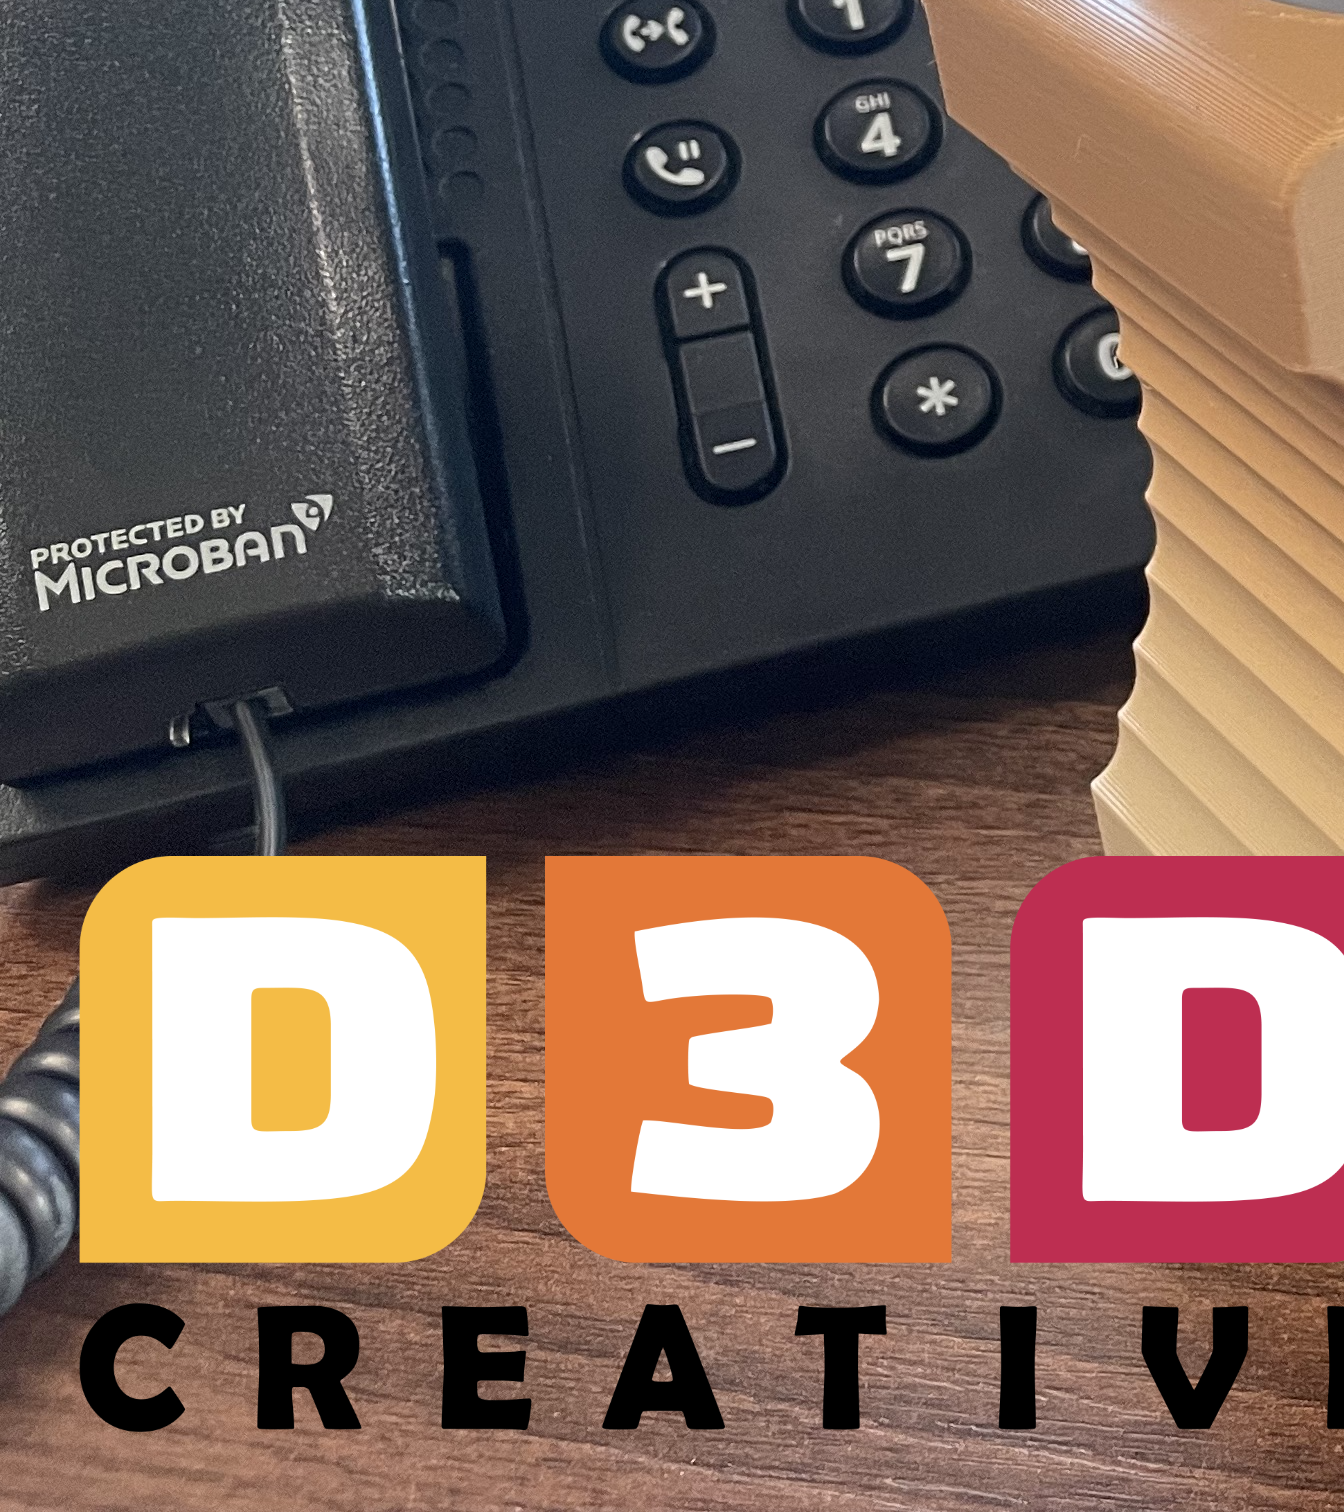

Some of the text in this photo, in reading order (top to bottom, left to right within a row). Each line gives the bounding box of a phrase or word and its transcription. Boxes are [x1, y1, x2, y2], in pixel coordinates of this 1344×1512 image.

[854, 92, 892, 113] GHI
[860, 112, 902, 158] 4
[885, 243, 925, 294] 7
[30, 503, 246, 569] PROTECTED BY
[34, 523, 308, 612] MICROBAN
